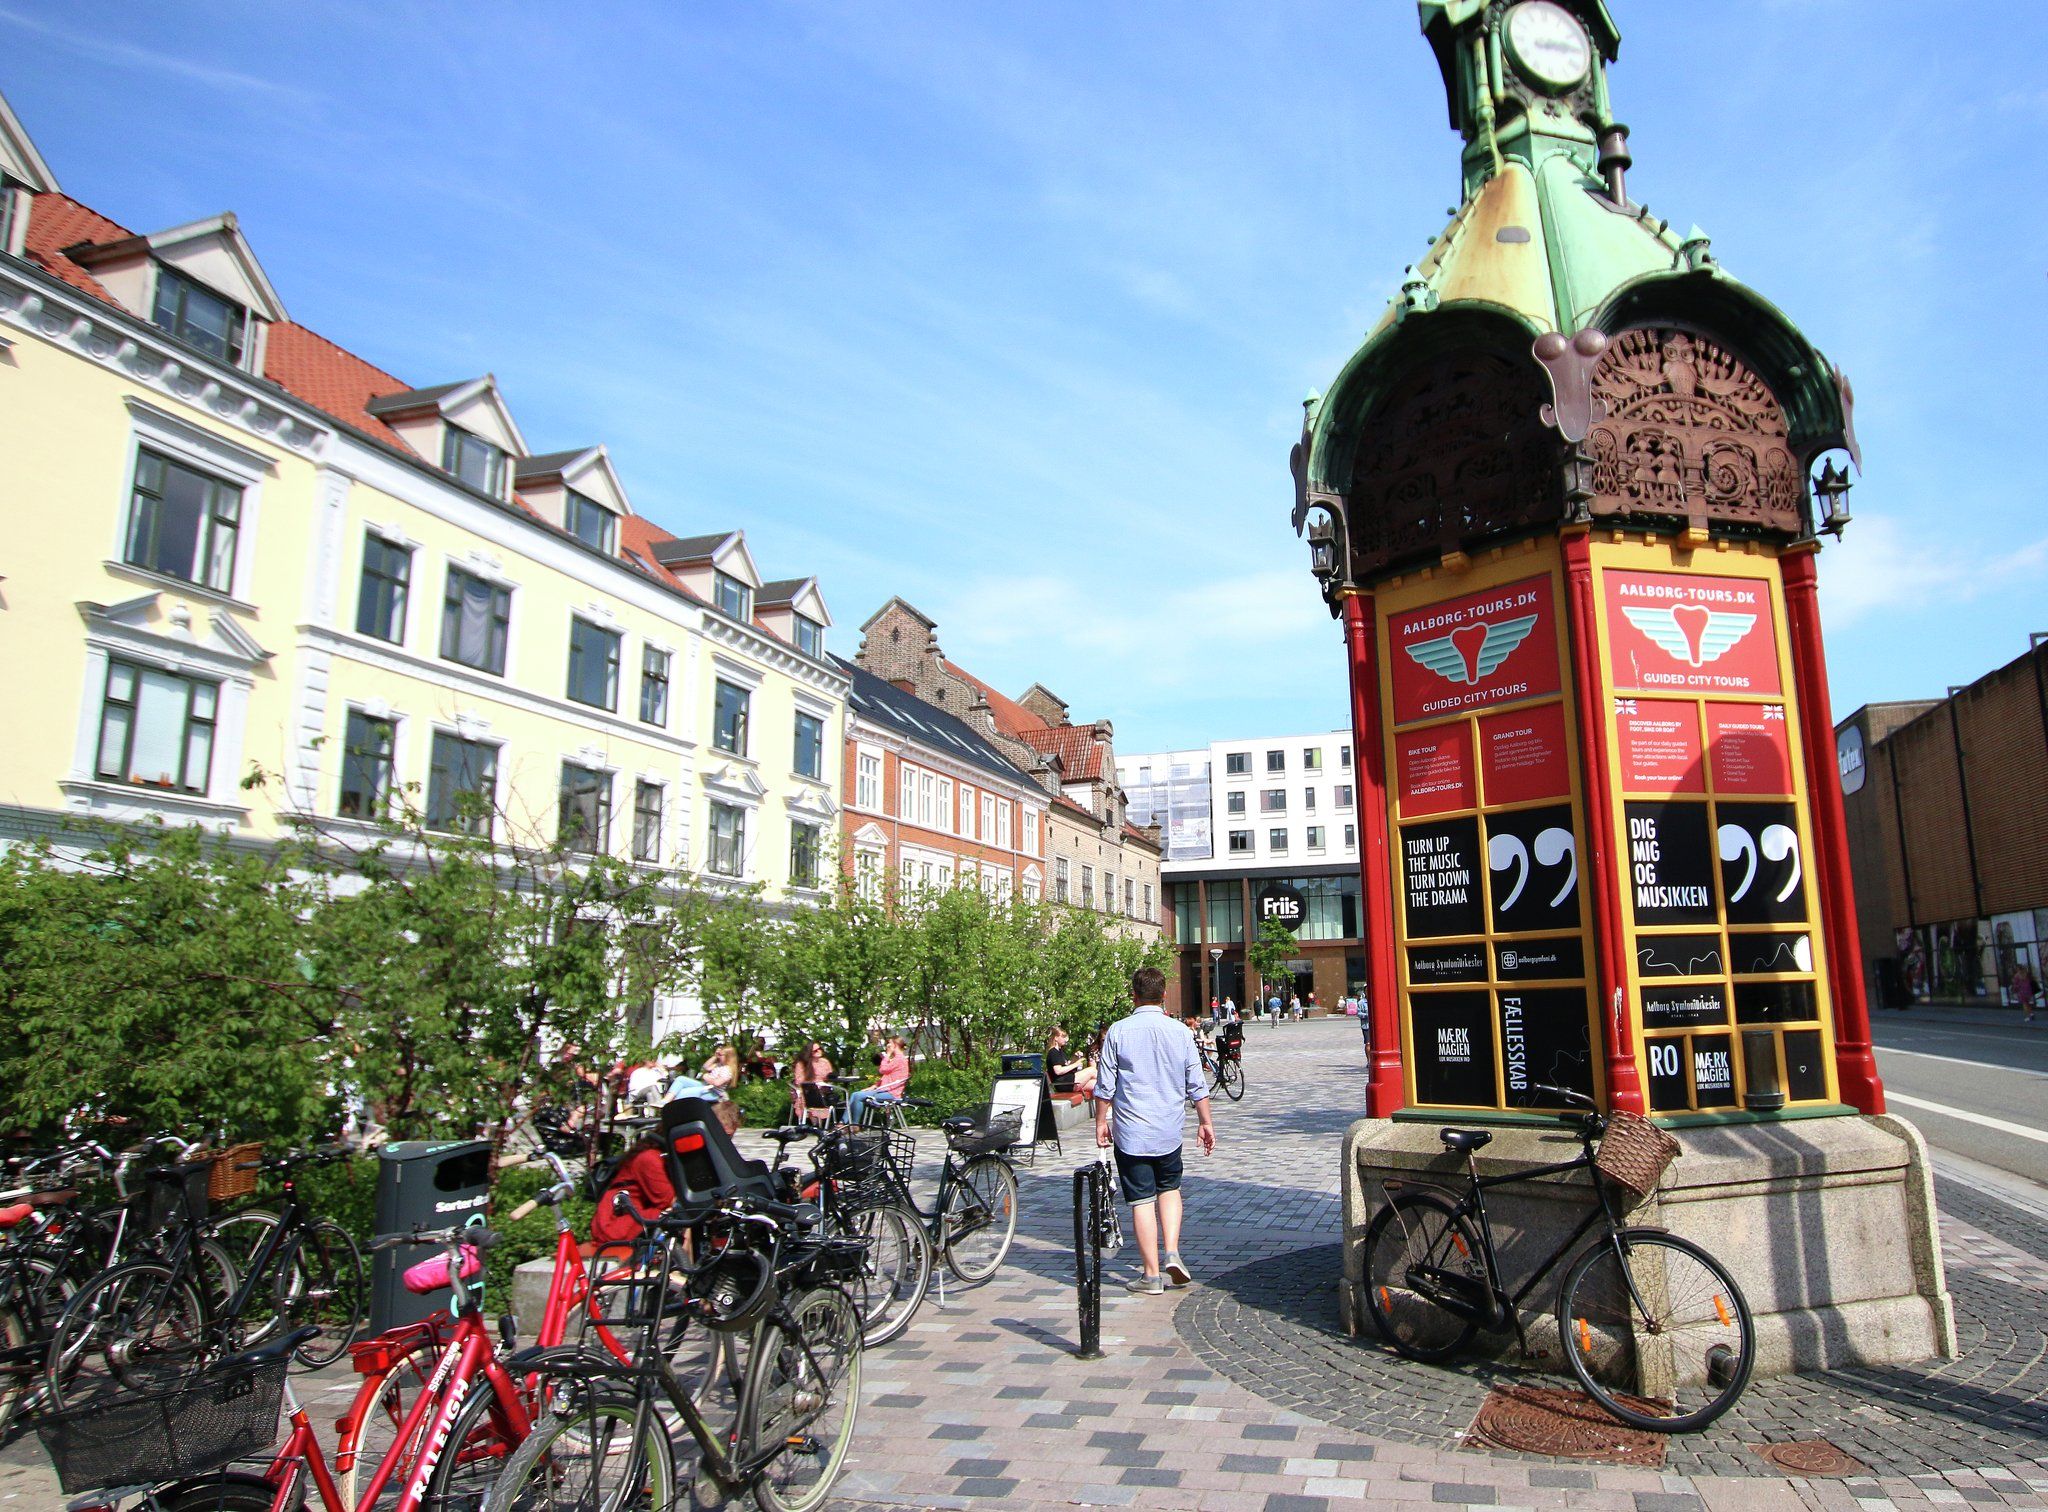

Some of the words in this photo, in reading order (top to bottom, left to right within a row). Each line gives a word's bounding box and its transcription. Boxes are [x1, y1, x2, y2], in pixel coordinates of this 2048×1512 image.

[1619, 583, 1756, 603] AALBORG-TOURS.DK
[1403, 590, 1537, 635] AALBORG-TOURS.DK
[1643, 673, 1685, 685] GUIDED
[1687, 674, 1712, 686] CITY
[1714, 676, 1750, 688] TOURS
[1422, 696, 1461, 712] GUIDED
[1464, 690, 1488, 704] CITY
[1490, 682, 1528, 698] TOURS
[1493, 731, 1515, 740] GRAND
[1515, 728, 1532, 737] TOUR
[1408, 748, 1421, 756] BIKE
[1421, 746, 1437, 754] TOUR
[1411, 782, 1464, 795] AALBORG-TOURS.DK
[1630, 818, 1656, 840] DIG
[1407, 838, 1433, 855] TURN
[1436, 836, 1450, 852] UP
[1633, 840, 1660, 862] MIG
[1408, 857, 1427, 873] THE
[1429, 852, 1461, 869] MUSIC
[1409, 873, 1436, 890] TURN
[1438, 869, 1470, 886] DOWN
[1634, 863, 1657, 885] OG
[1263, 897, 1299, 915] Friis
[1410, 891, 1429, 908] THE
[1431, 888, 1468, 906] DRAMA
[1637, 886, 1709, 908] MUSIKKEN
[1414, 960, 1435, 972] Aalborg
[1518, 954, 1557, 965] aalborgsymfoni.dk
[1646, 1000, 1670, 1014] Aalborg
[1438, 1028, 1469, 1043] MÆRK
[1504, 997, 1527, 1090] FÆLLESSKAB
[1438, 1043, 1470, 1056] MAGIEN
[1650, 1044, 1679, 1077] RO
[1695, 1051, 1729, 1069] MÆRK
[1696, 1067, 1730, 1083] MAGIEN
[435, 1200, 471, 1213] Sorter
[410, 1378, 470, 1503] RALEIGH
